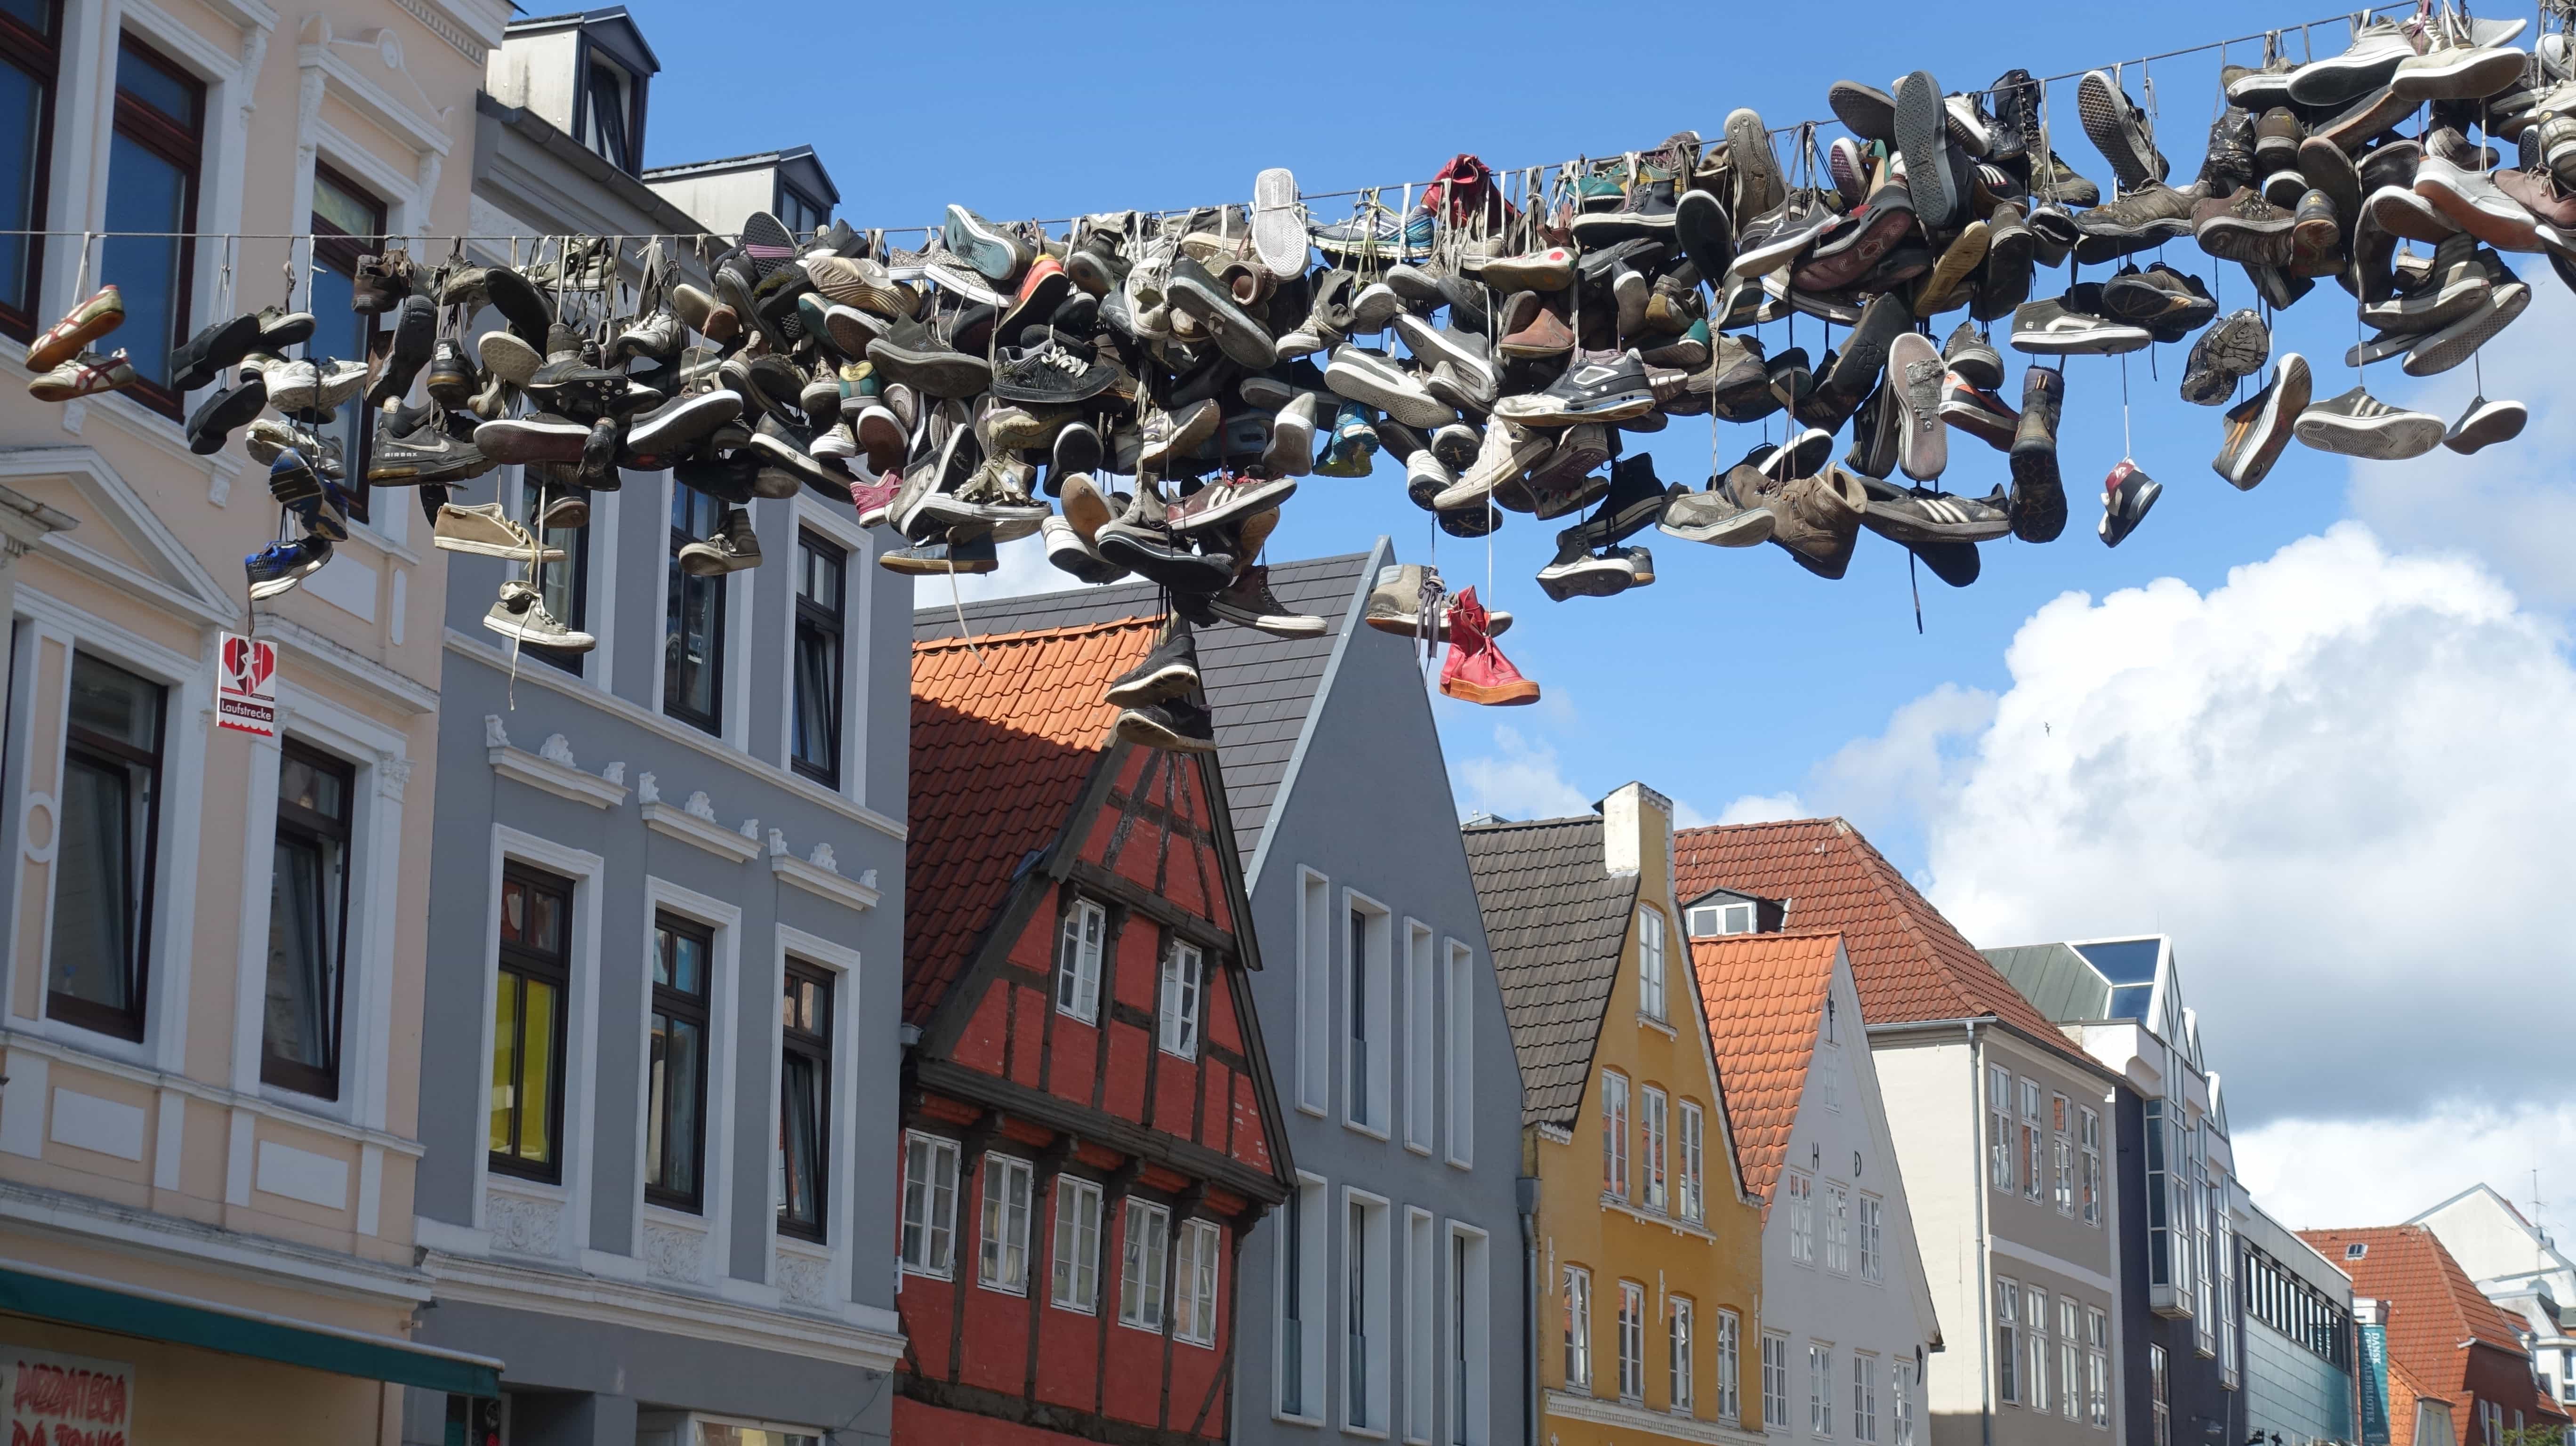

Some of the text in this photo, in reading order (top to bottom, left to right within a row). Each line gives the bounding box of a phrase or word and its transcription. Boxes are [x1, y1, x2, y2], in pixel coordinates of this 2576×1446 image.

[221, 700, 271, 720] Laufstrecke
[2371, 1333, 2381, 1364] DANSK
[14, 1359, 126, 1425] PIZZATECA
